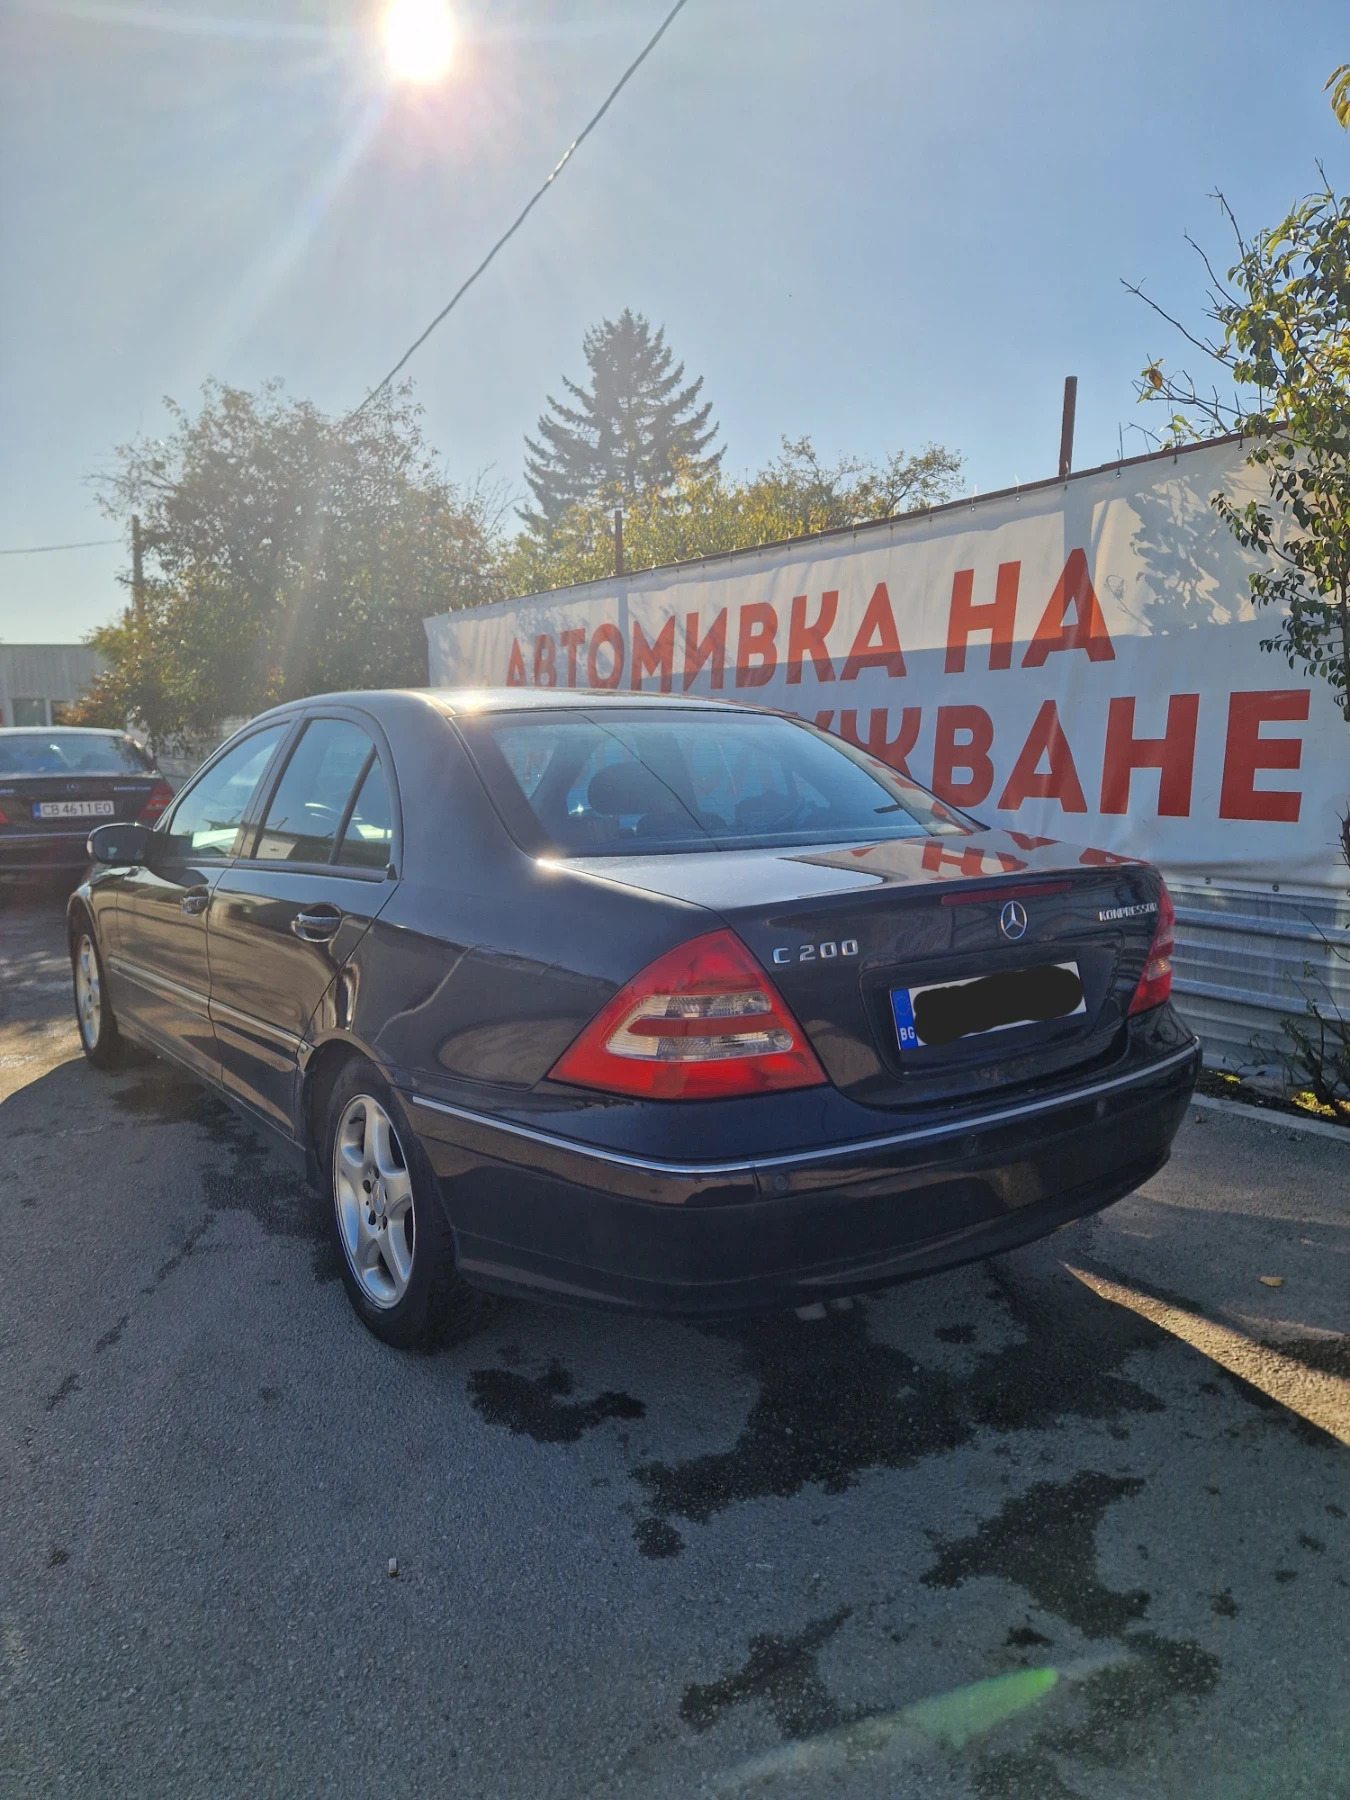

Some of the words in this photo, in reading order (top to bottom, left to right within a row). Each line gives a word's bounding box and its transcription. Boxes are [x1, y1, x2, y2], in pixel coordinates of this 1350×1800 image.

[507, 582, 907, 693] АВТОМИВКА
[944, 547, 1115, 675] НА
[773, 947, 790, 964] C
[799, 939, 859, 962] 200
[900, 1026, 915, 1041] BG
